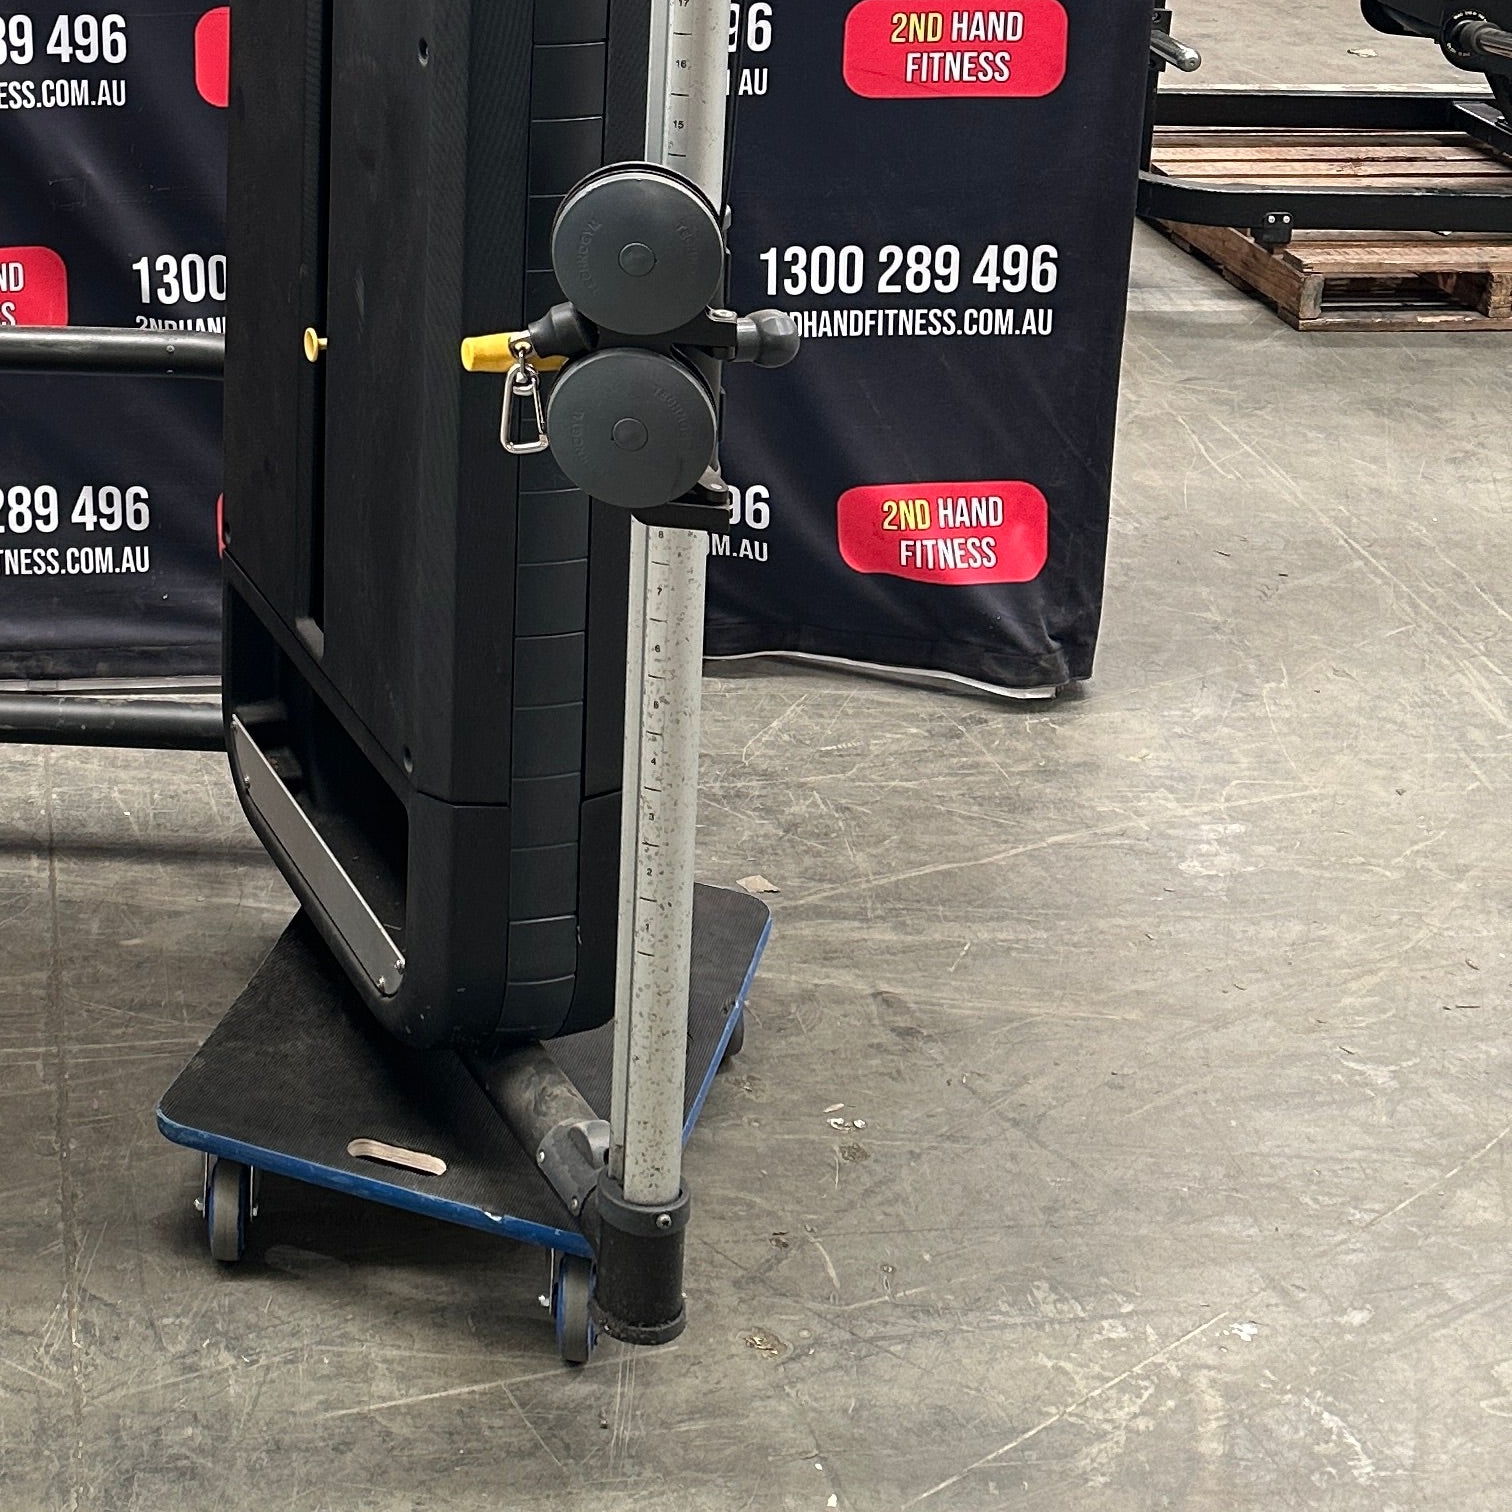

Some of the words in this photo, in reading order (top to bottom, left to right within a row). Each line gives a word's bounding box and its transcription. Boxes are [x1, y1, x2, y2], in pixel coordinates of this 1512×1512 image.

[46, 13, 127, 64] 496
[890, 12, 943, 44] 2ND
[950, 10, 1024, 43] HAND
[676, 59, 687, 68] 16
[905, 51, 1011, 83] FITNESS
[673, 120, 684, 129] 15
[132, 253, 227, 305] 1300
[759, 245, 864, 296] 1300
[877, 244, 961, 294] 289
[972, 243, 1058, 293] 496
[784, 308, 1053, 338] DHANDFITNESS.COM.AU
[70, 485, 150, 533] 496
[881, 500, 931, 531] 2ND
[937, 496, 1004, 528] HAND
[899, 536, 997, 569] FITNESS
